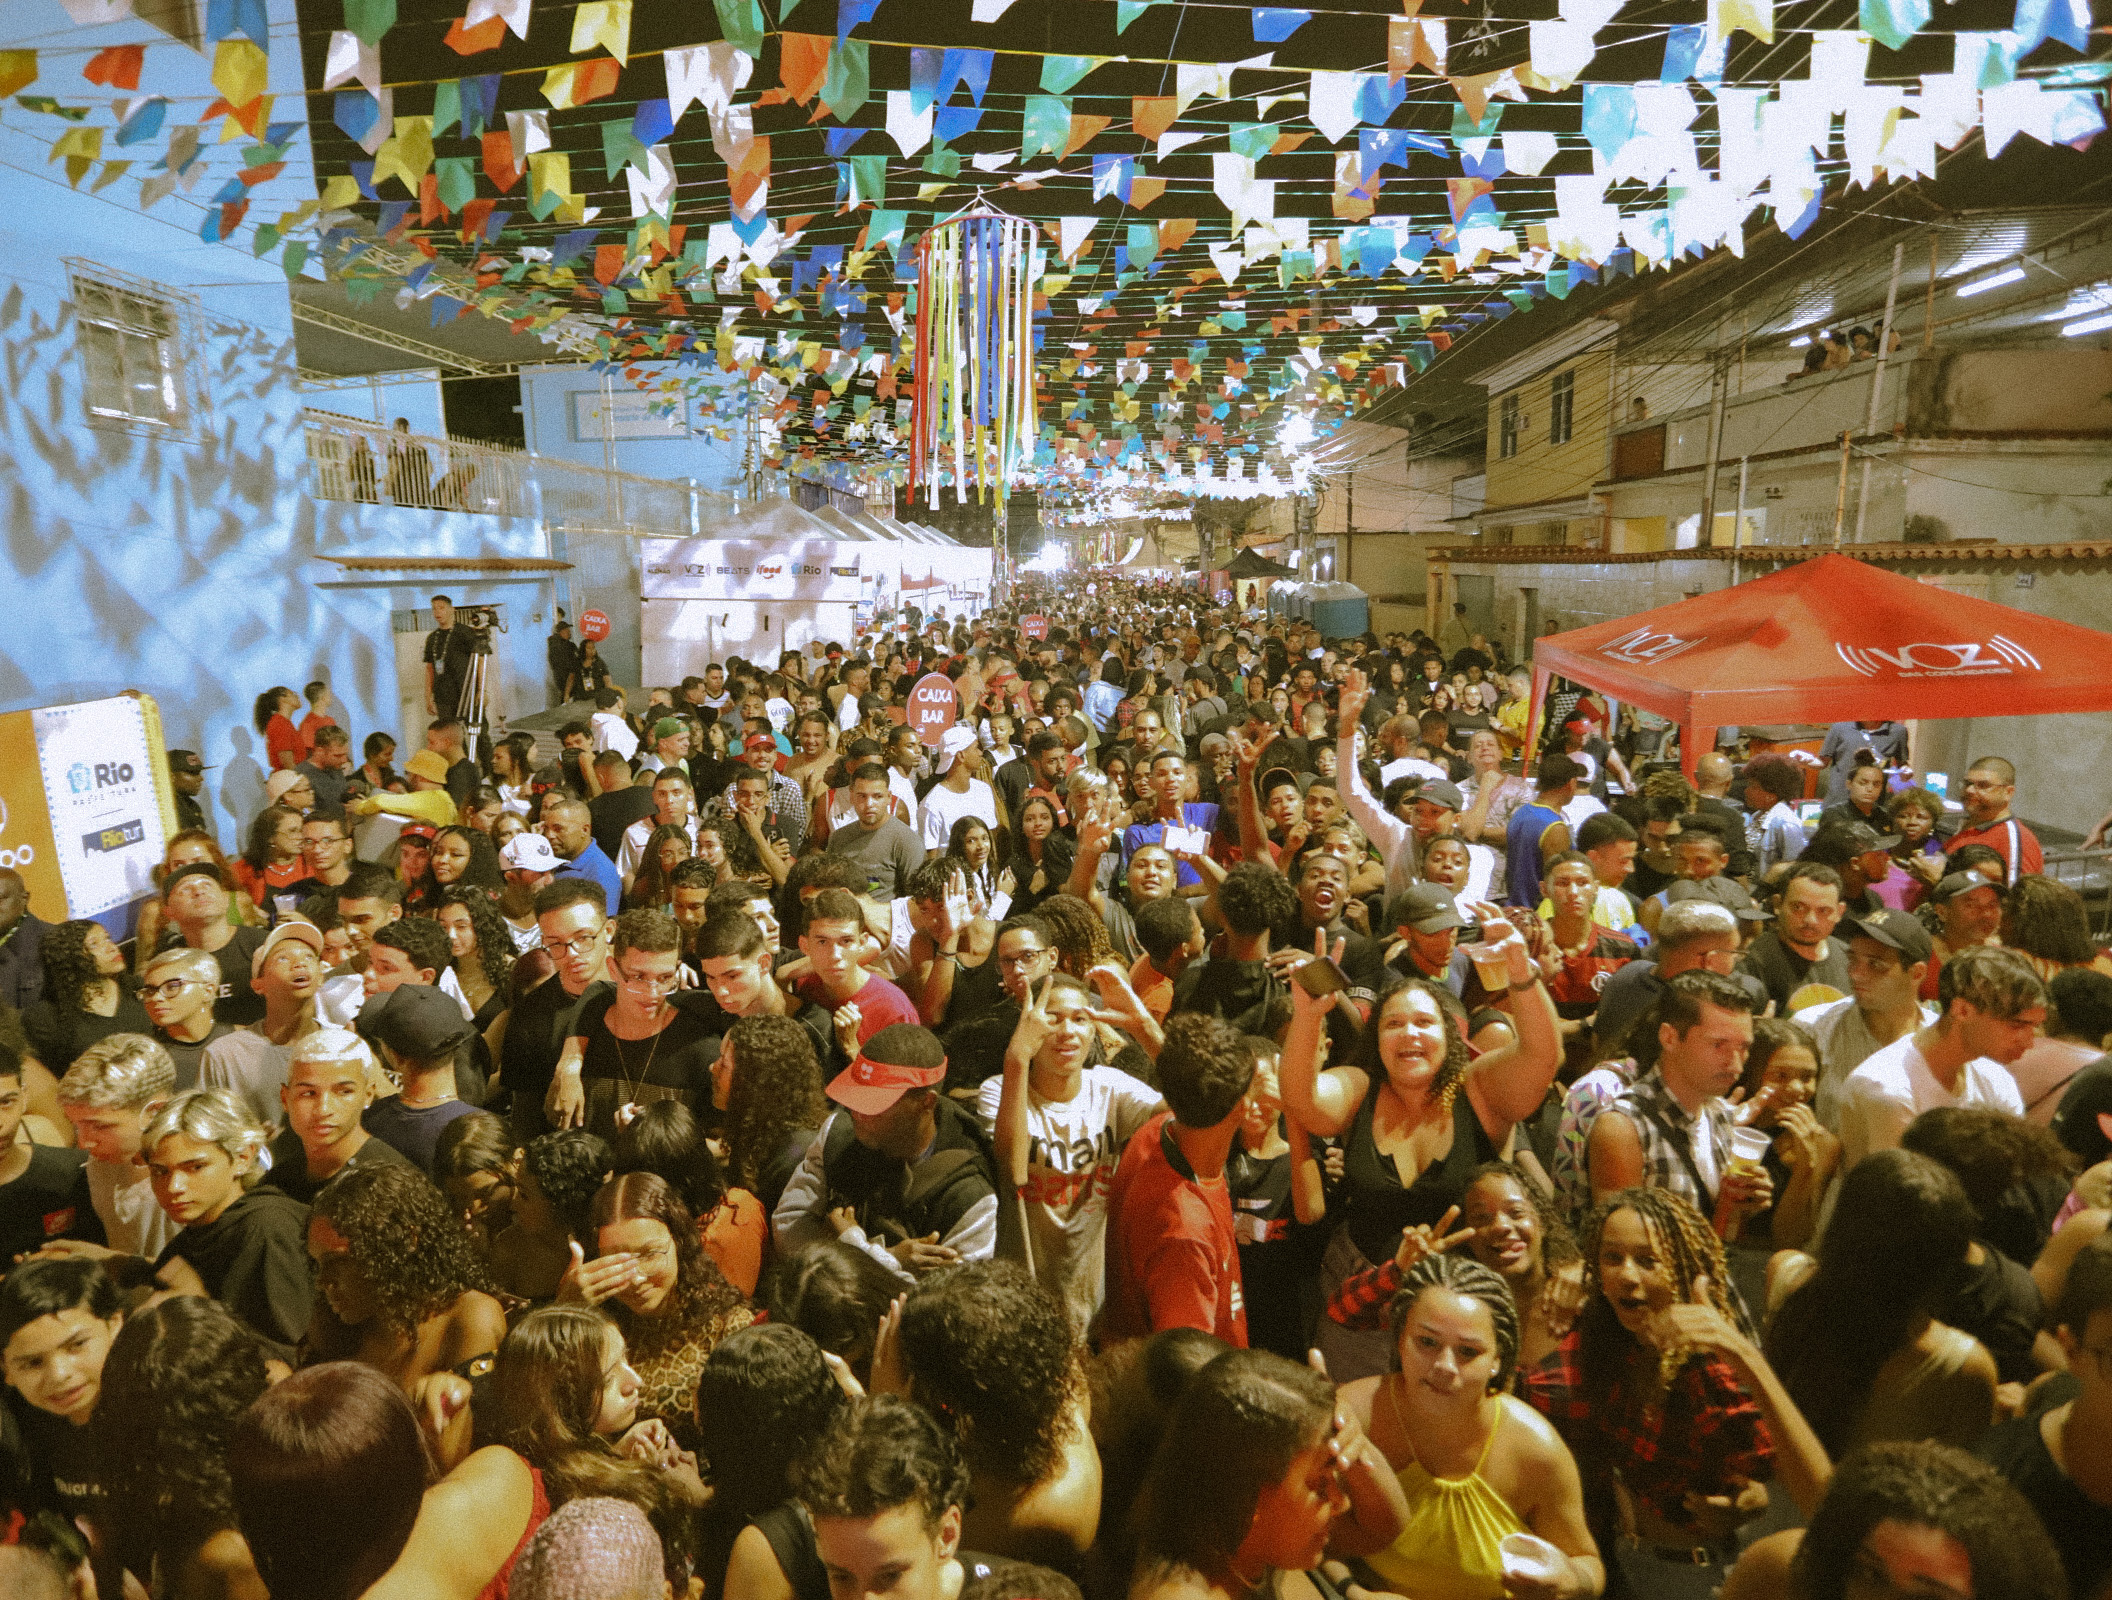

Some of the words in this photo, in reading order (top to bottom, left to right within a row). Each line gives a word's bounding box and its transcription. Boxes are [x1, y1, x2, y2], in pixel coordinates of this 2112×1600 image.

[684, 564, 705, 574] VOZ
[716, 566, 750, 575] BEATS
[803, 565, 821, 575] Rio
[583, 614, 607, 624] CAIXA
[1025, 620, 1044, 628] CAIXA
[586, 624, 601, 633] BAR
[1619, 632, 1684, 657] VOZ
[1866, 643, 2000, 670] VOZ
[917, 688, 953, 703] CAIXA
[921, 709, 944, 724] BAR
[94, 762, 134, 788] Rio
[101, 825, 142, 849] Riotur
